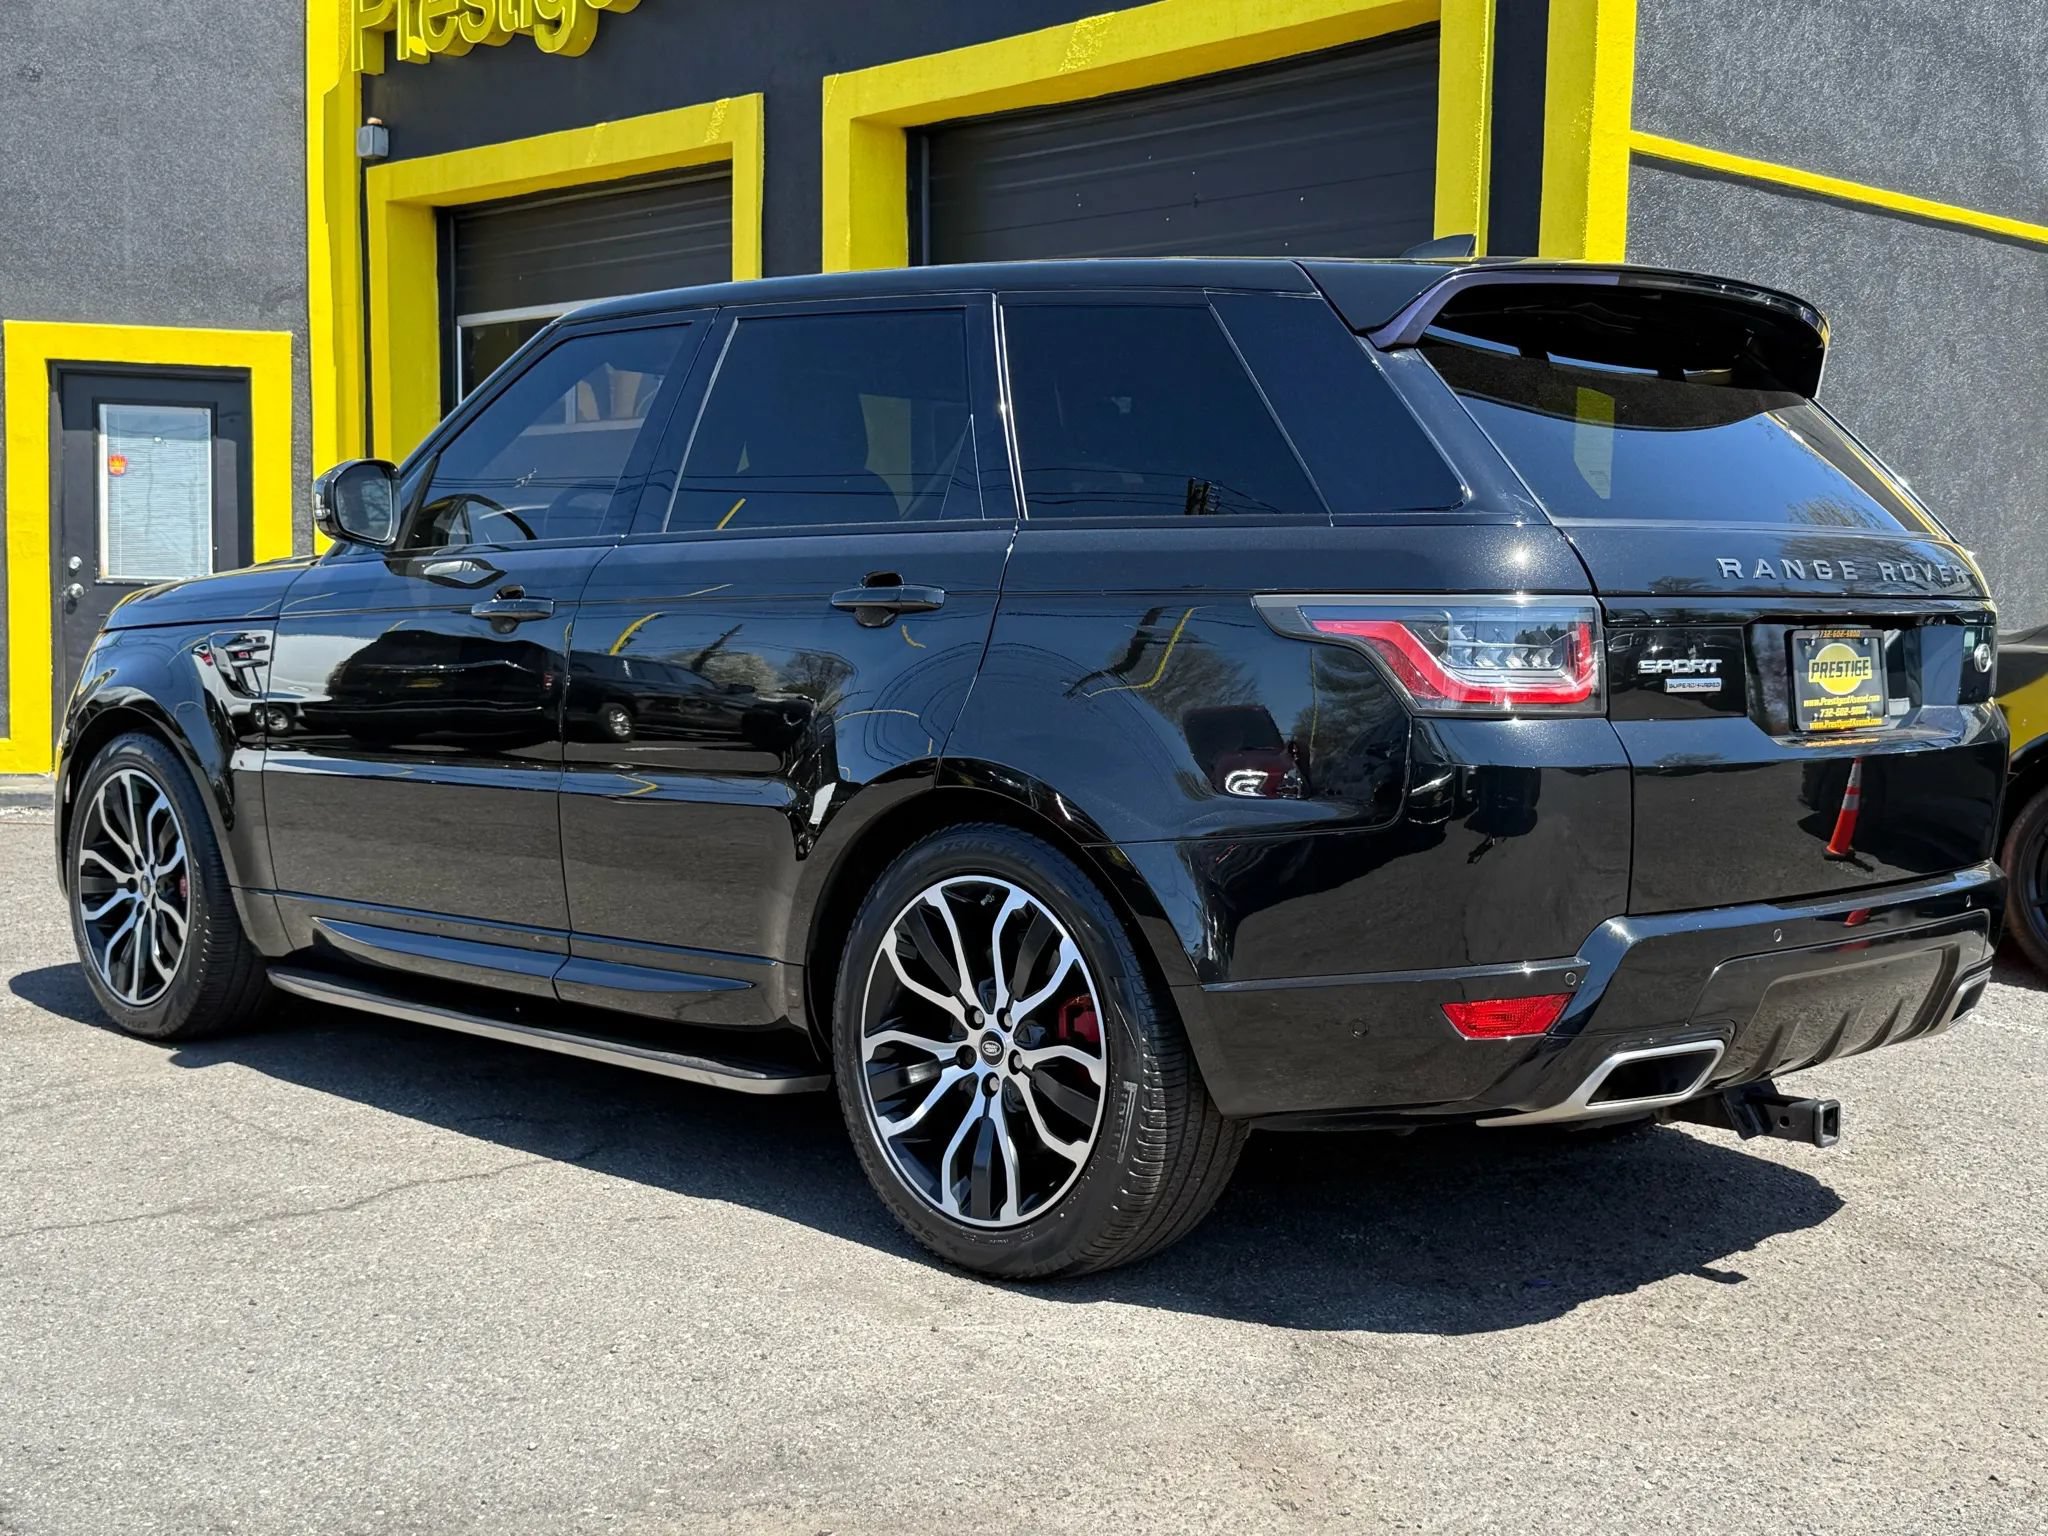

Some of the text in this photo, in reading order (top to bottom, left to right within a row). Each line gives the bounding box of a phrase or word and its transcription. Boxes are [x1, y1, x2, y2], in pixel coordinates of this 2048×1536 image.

[1716, 558, 1968, 584] RANGE ROVER
[1638, 659, 1722, 674] SPORT
[1811, 660, 1869, 679] PRESTIGE
